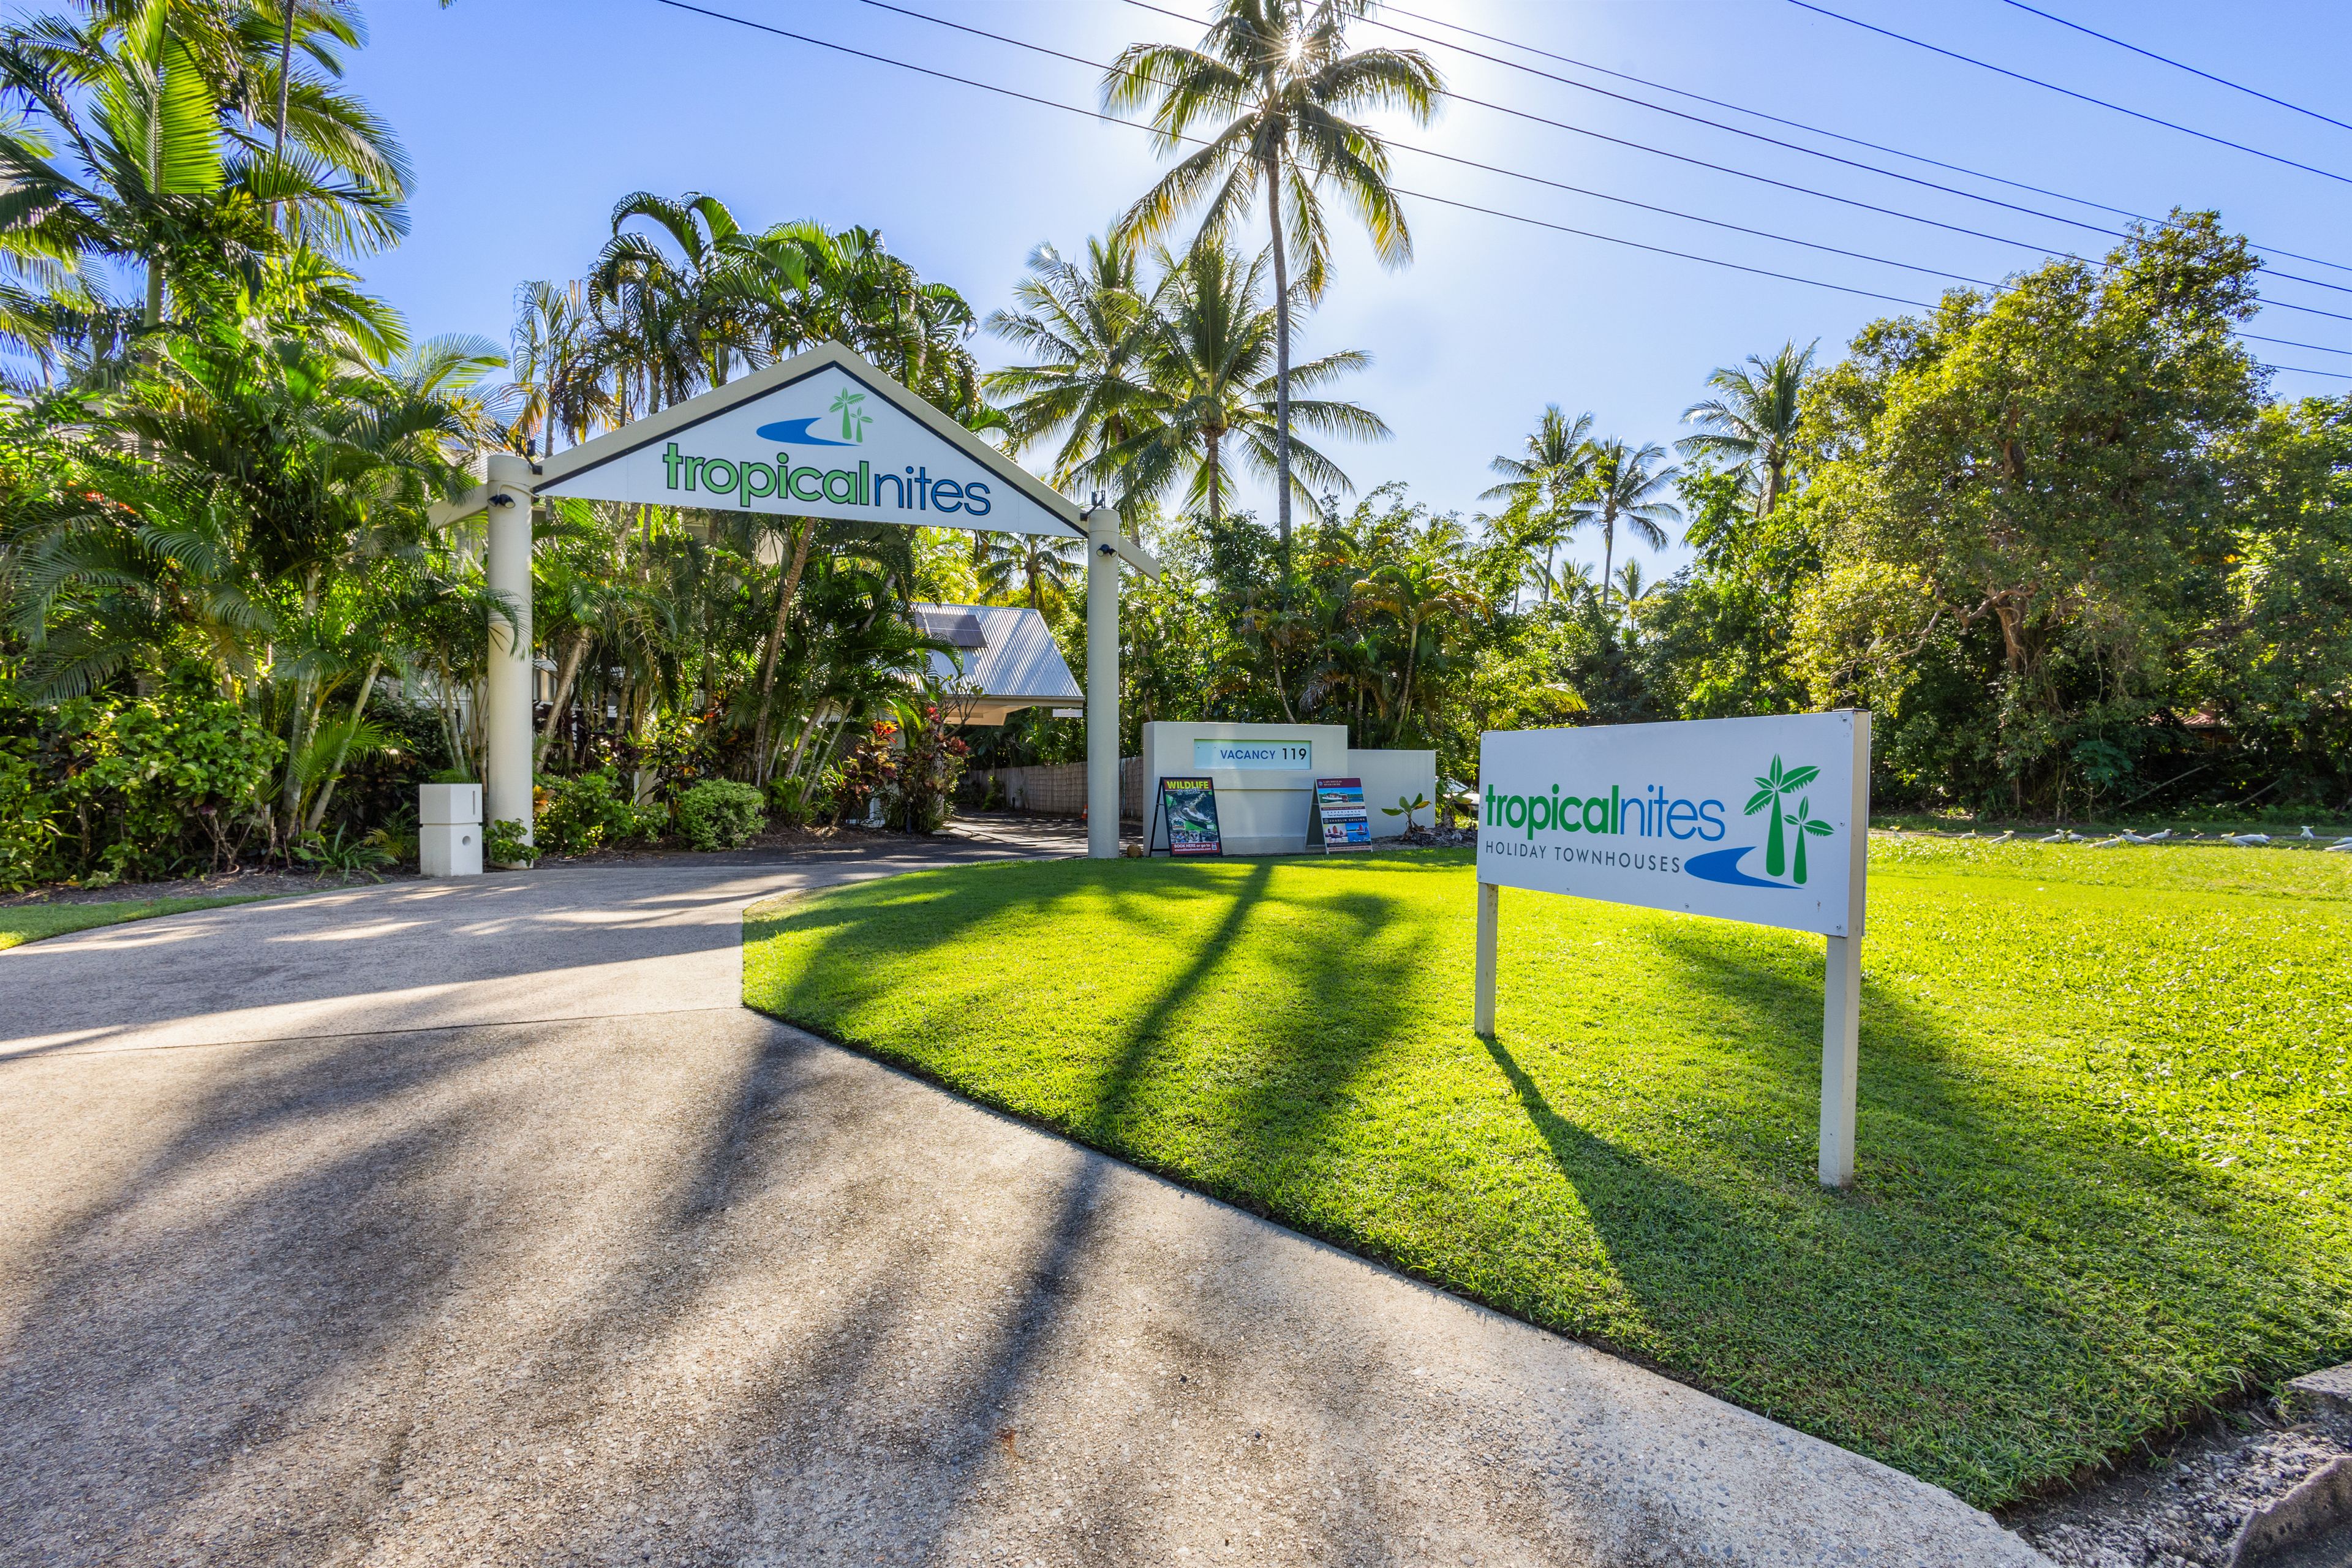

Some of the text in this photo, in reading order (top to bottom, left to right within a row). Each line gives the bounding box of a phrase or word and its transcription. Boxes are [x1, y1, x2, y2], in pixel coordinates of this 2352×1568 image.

[663, 442, 991, 516] tropicalnites
[1220, 748, 1306, 760] VACANCY 119
[1485, 783, 1725, 842] tropicalnites
[1485, 840, 1680, 873] HOLIDAY TOWNHOUSES
